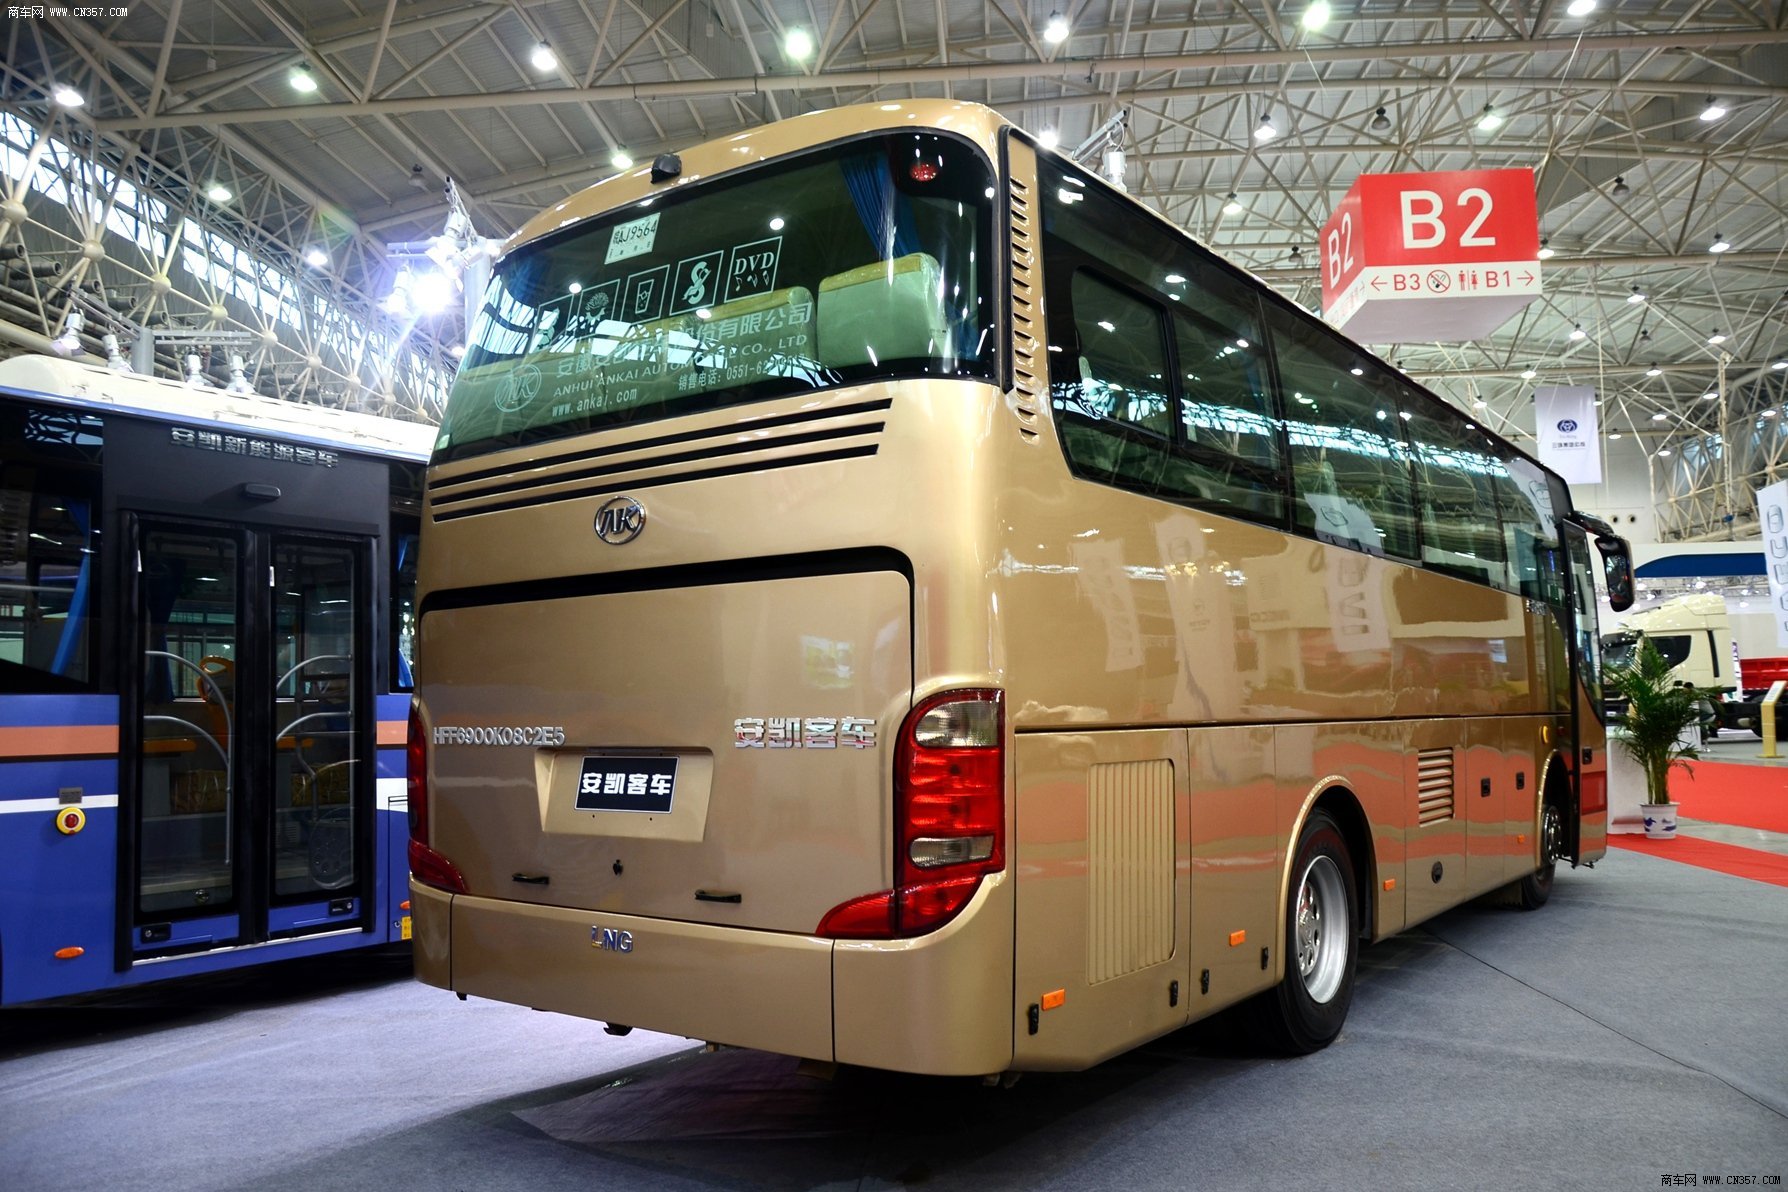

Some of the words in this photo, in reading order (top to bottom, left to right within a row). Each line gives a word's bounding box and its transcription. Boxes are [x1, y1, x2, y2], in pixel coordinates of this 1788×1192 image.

[1400, 187, 1496, 249] B2
[733, 252, 775, 275] DVD
[1328, 212, 1354, 290] B2
[1393, 273, 1421, 291] B3
[1485, 270, 1511, 288] B1
[553, 379, 594, 397] ANHUI
[596, 368, 638, 387] ANKAI
[778, 334, 807, 349] LTD
[552, 388, 638, 417] www.ankai.com
[171, 427, 339, 468] 安凯新能源客车
[734, 717, 877, 749] 安凯客车
[581, 772, 673, 796] 安凯客车
[591, 925, 633, 953] LNG
